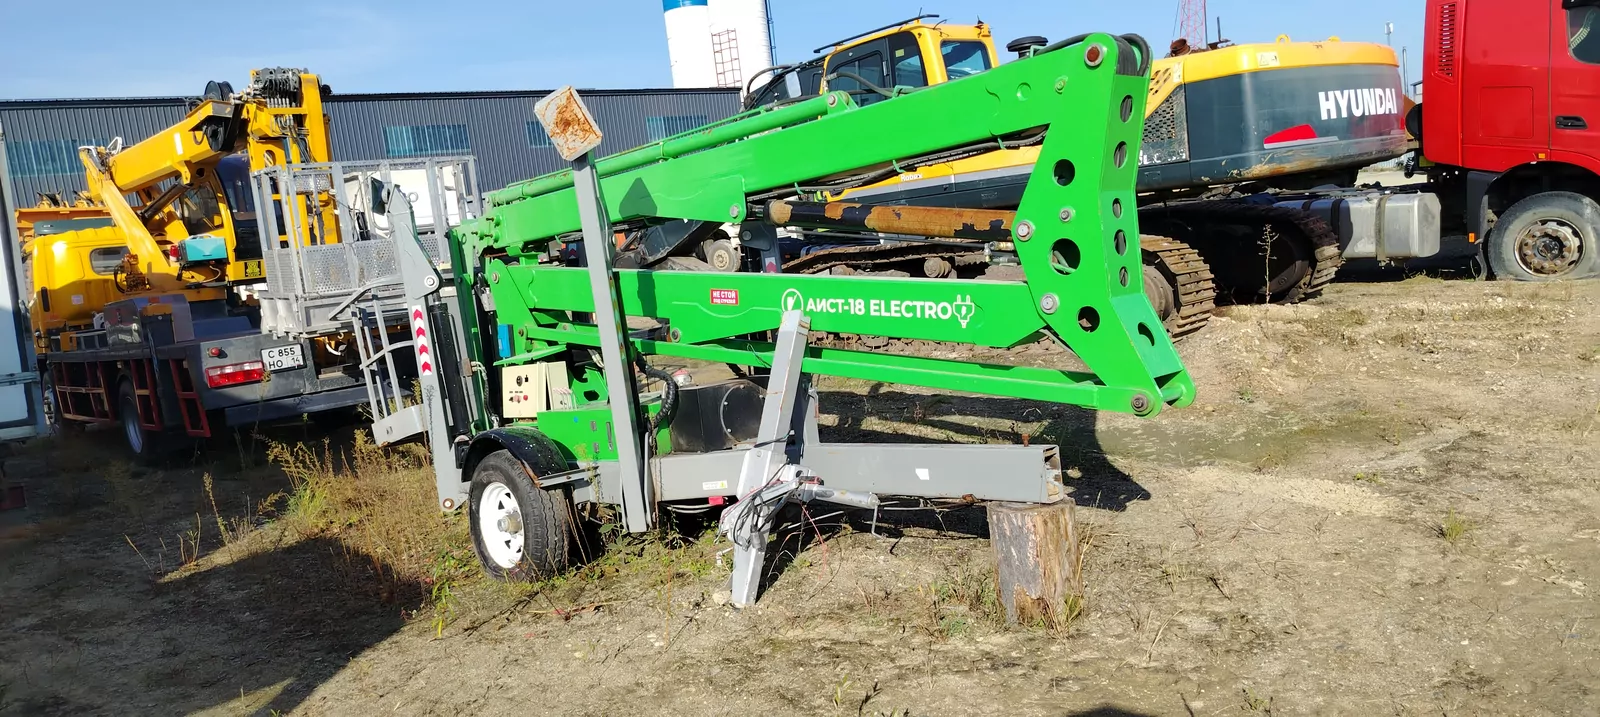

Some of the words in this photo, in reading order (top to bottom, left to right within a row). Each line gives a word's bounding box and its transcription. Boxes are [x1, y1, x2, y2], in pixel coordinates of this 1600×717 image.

[1318, 88, 1397, 120] HYUNDAI
[712, 290, 720, 298] НЕ
[720, 290, 736, 299] СТОЙ
[806, 298, 865, 316] АИСТ-18
[870, 299, 952, 320] ELECTRO
[278, 347, 295, 357] 855
